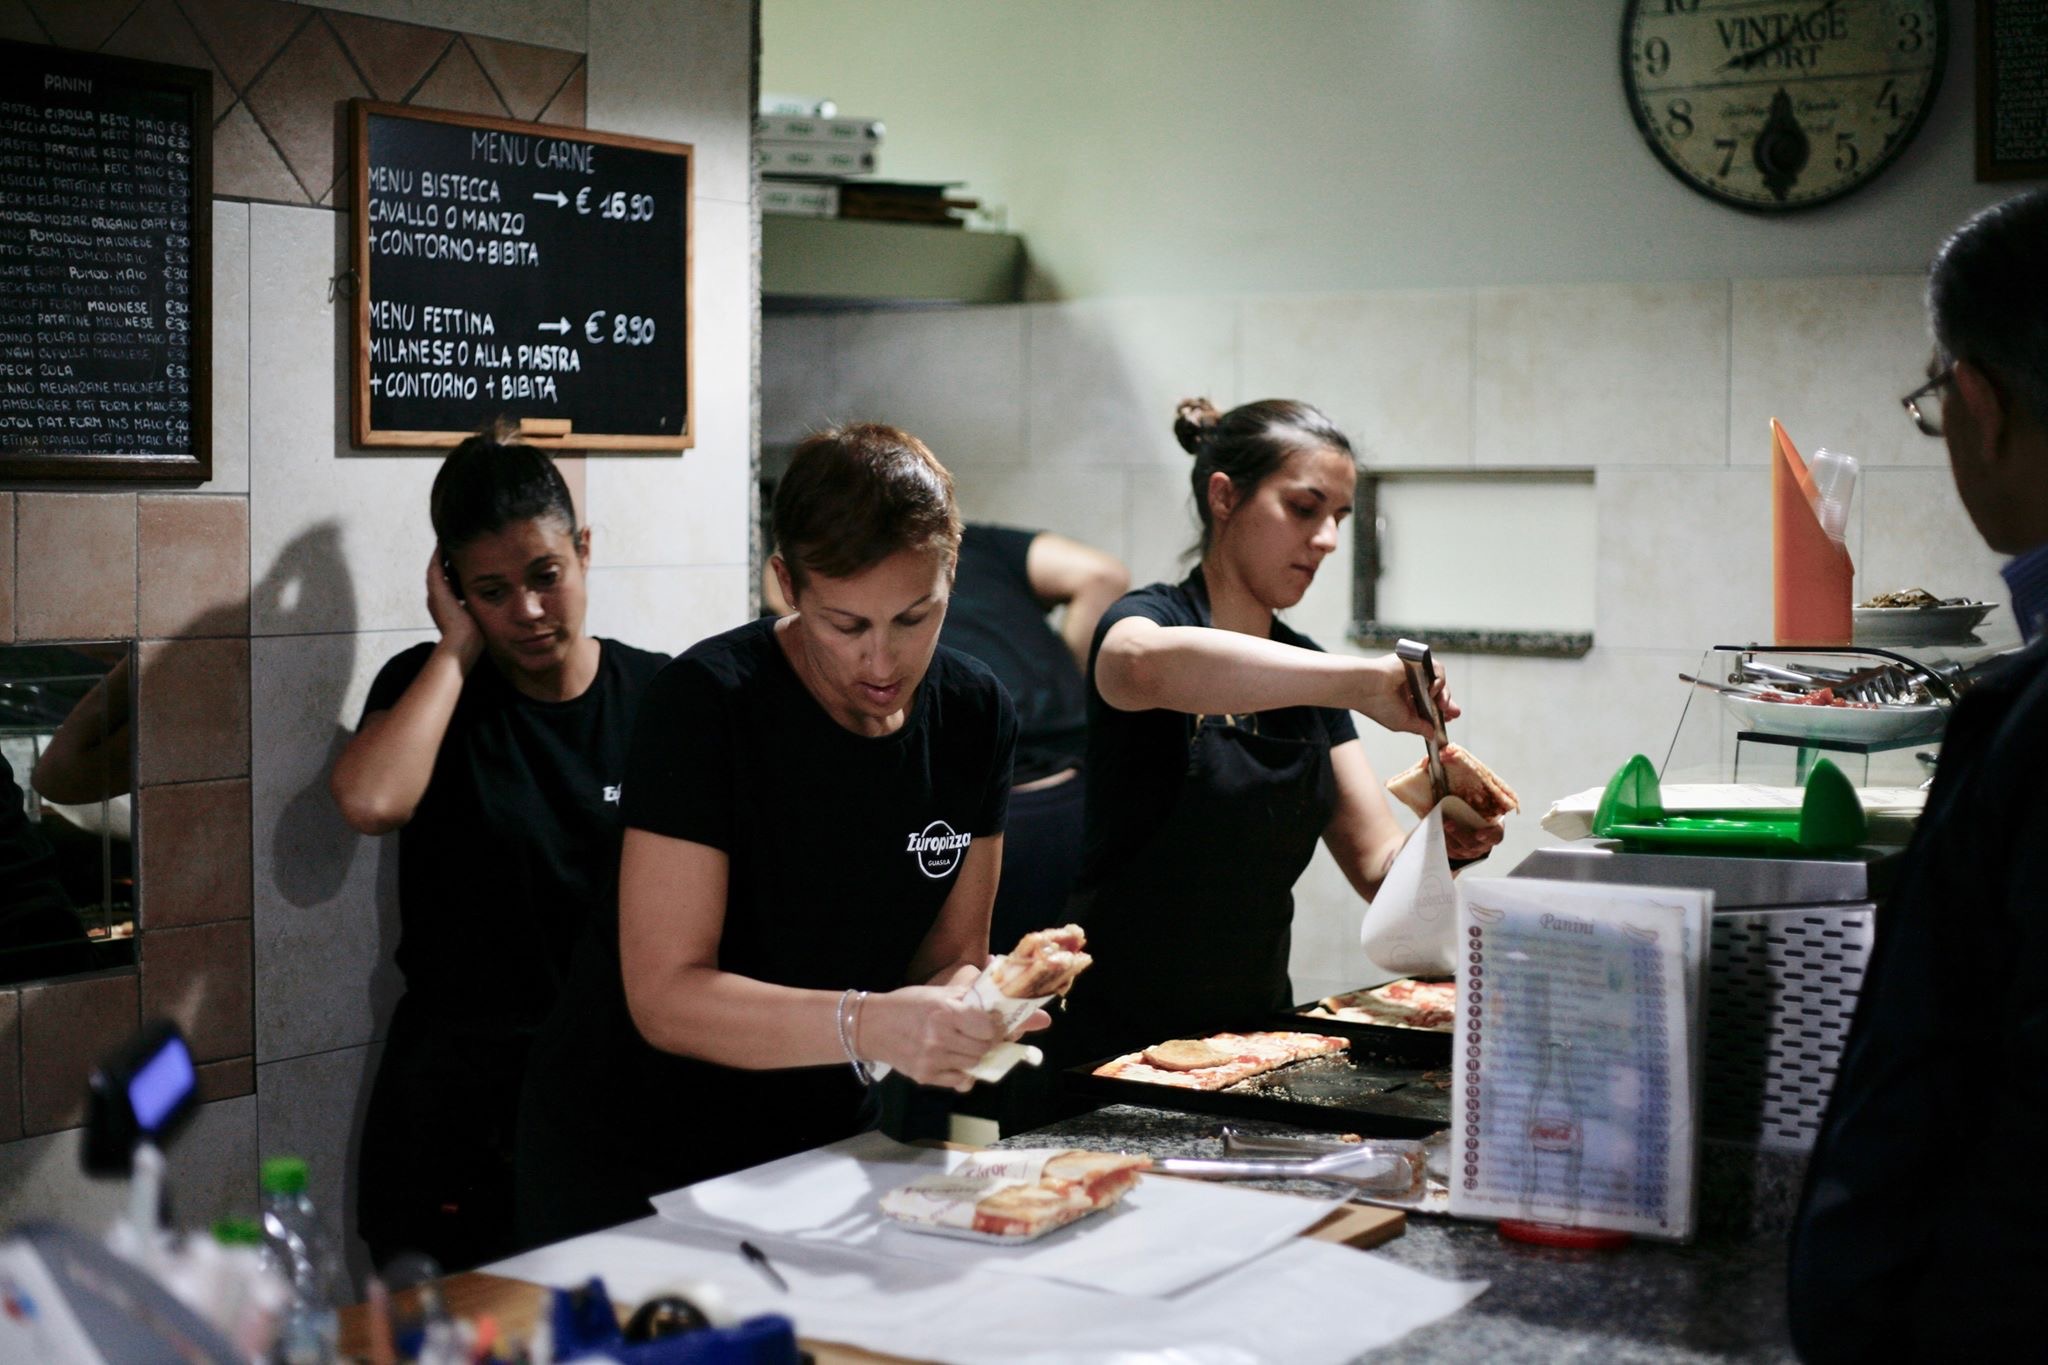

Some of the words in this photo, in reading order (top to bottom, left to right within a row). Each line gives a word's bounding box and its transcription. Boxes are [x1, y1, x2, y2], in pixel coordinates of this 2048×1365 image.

[1715, 7, 1850, 50] VINTAGE
[1899, 12, 1923, 54] 3
[1644, 36, 1670, 77] 9
[44, 73, 94, 94] PANINI
[1876, 78, 1900, 119] 4
[1665, 97, 1695, 140] 8
[471, 131, 528, 166] MENU
[535, 138, 596, 174] CARNE
[1713, 138, 1739, 178] 7
[1834, 132, 1860, 173] 5
[367, 166, 412, 194] MENU
[421, 171, 501, 204] BISTECCA
[576, 186, 592, 215] €
[367, 198, 438, 228] CAVALLO
[445, 205, 457, 229] O
[462, 209, 526, 237] MANZO
[87, 301, 149, 315] MAIONESE
[369, 300, 415, 332] MENU
[423, 306, 495, 336] FETTINA
[584, 310, 606, 344] €
[474, 343, 512, 369] ALLA
[517, 344, 581, 373] PIASTRA
[0, 399, 72, 412] AMBURGER
[907, 832, 971, 855] Europizza
[1540, 913, 1595, 935] Panini
